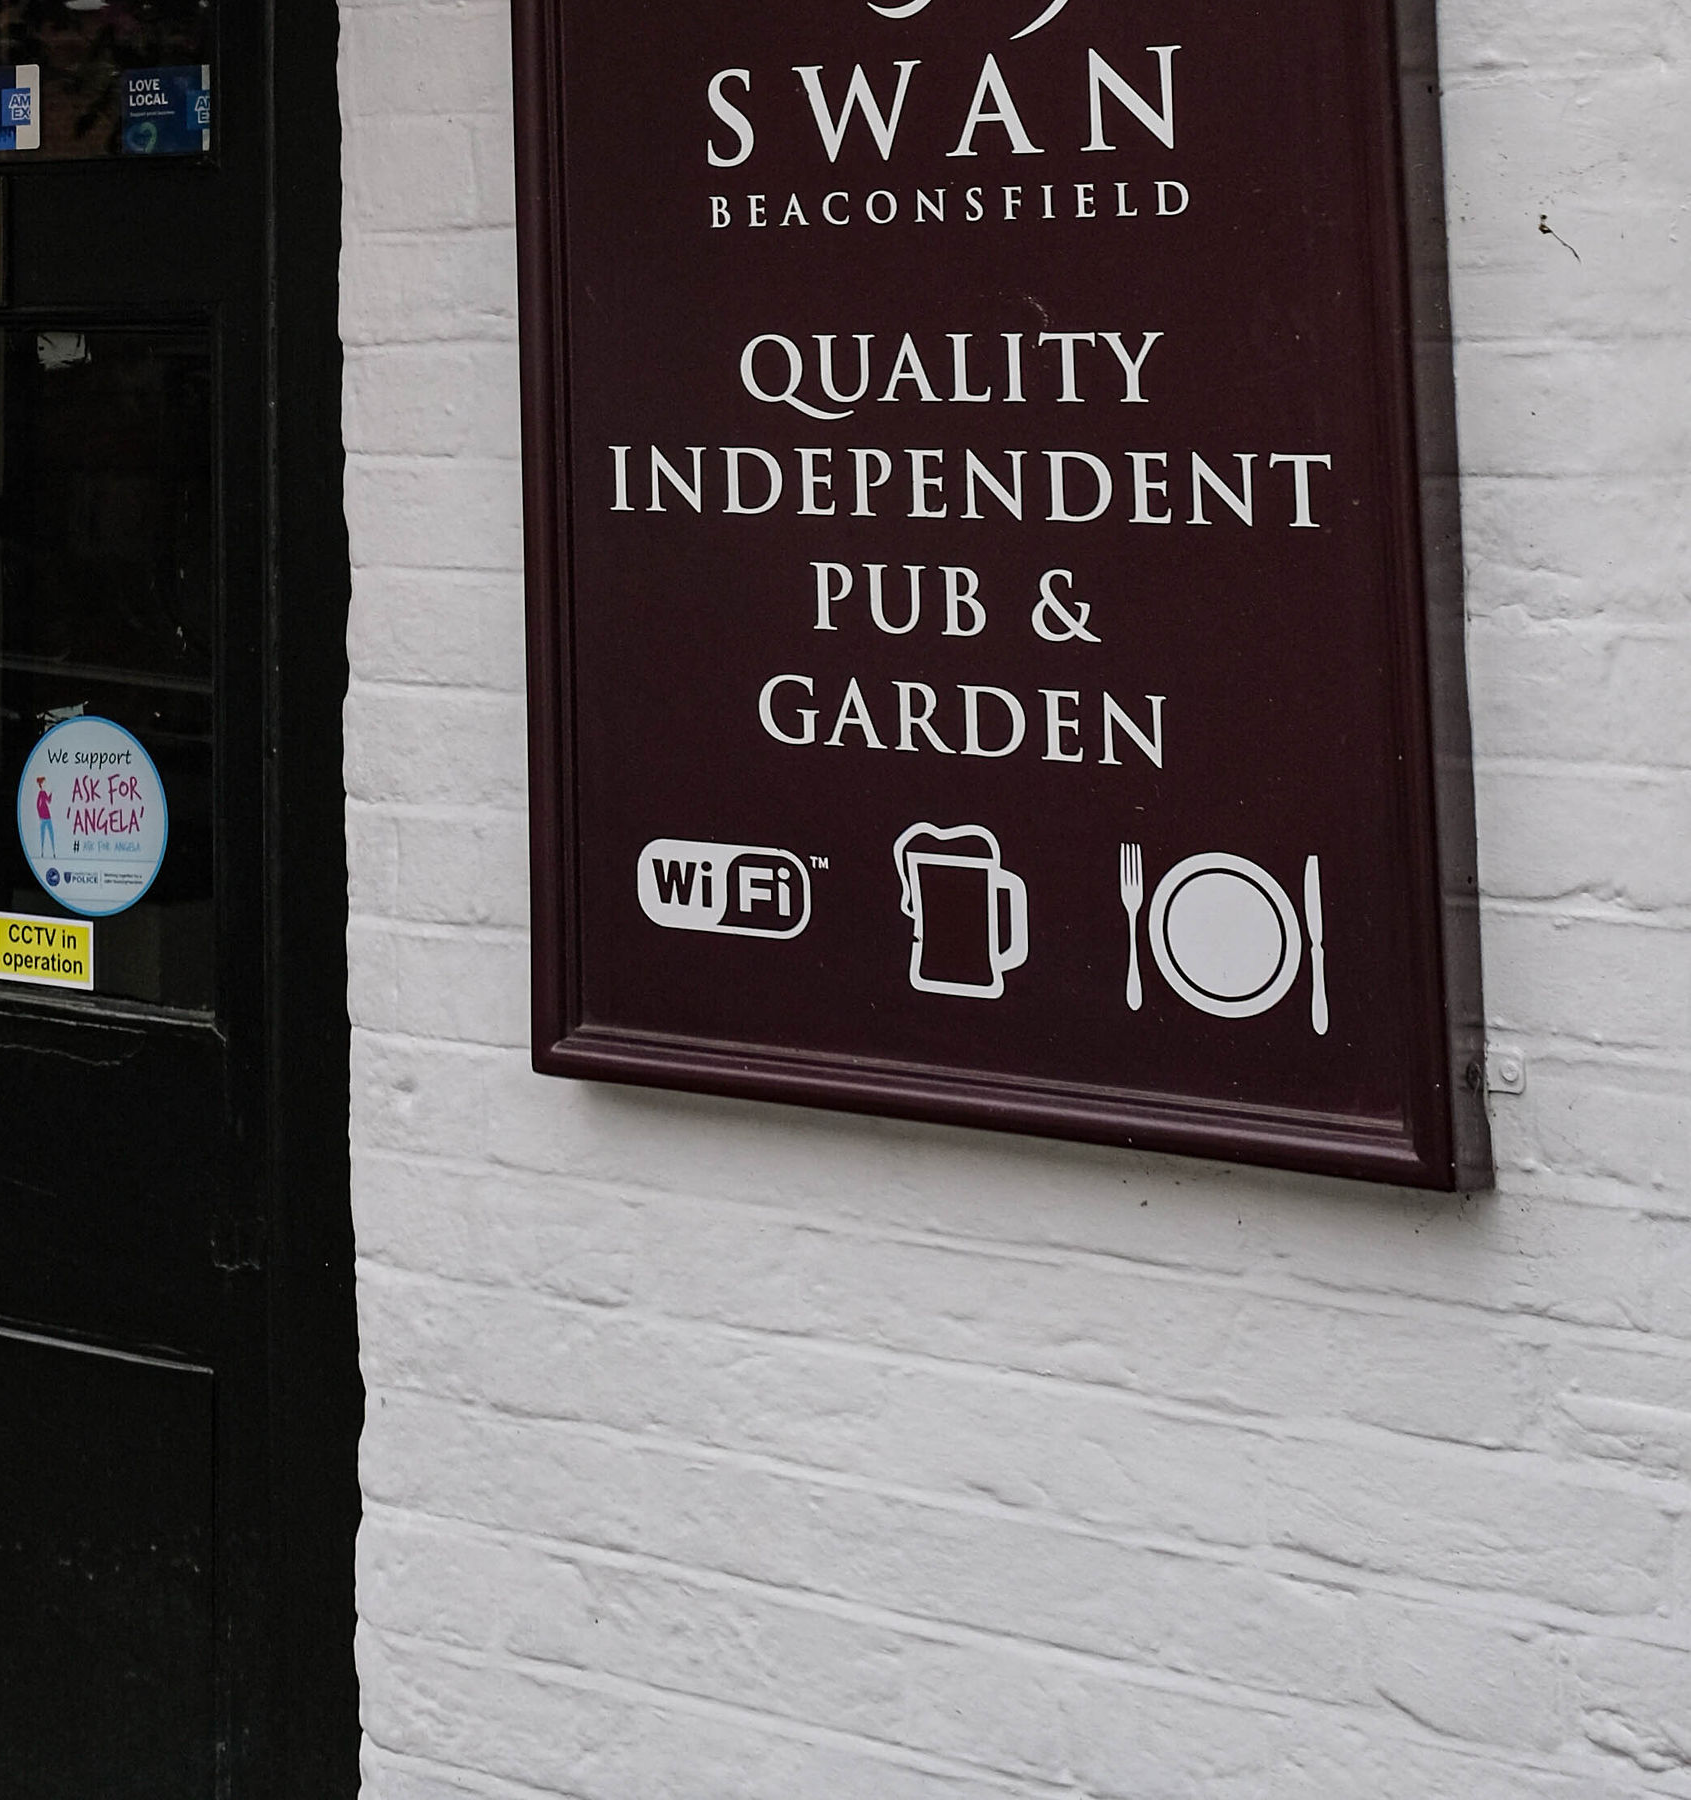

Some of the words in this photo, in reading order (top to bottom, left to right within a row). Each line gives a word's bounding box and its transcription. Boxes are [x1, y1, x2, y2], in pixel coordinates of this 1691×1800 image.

[129, 78, 160, 92] LOVE
[129, 93, 168, 107] LOCAL
[707, 44, 1182, 168] SWAN
[709, 180, 1190, 229] BEACONSFIELD
[739, 330, 1165, 421] QUALITY
[607, 444, 1333, 529] INDEPENDENT
[809, 561, 987, 637] PUB
[1030, 568, 1103, 644] &
[758, 674, 1167, 770] GARDEN
[47, 748, 69, 764] We
[74, 749, 132, 770] support
[71, 775, 101, 803] ASK
[107, 773, 142, 805] FOR
[72, 875, 98, 884] POLICE
[8, 924, 56, 948] CCTV
[62, 929, 77, 950] in
[2, 952, 83, 975] operation
